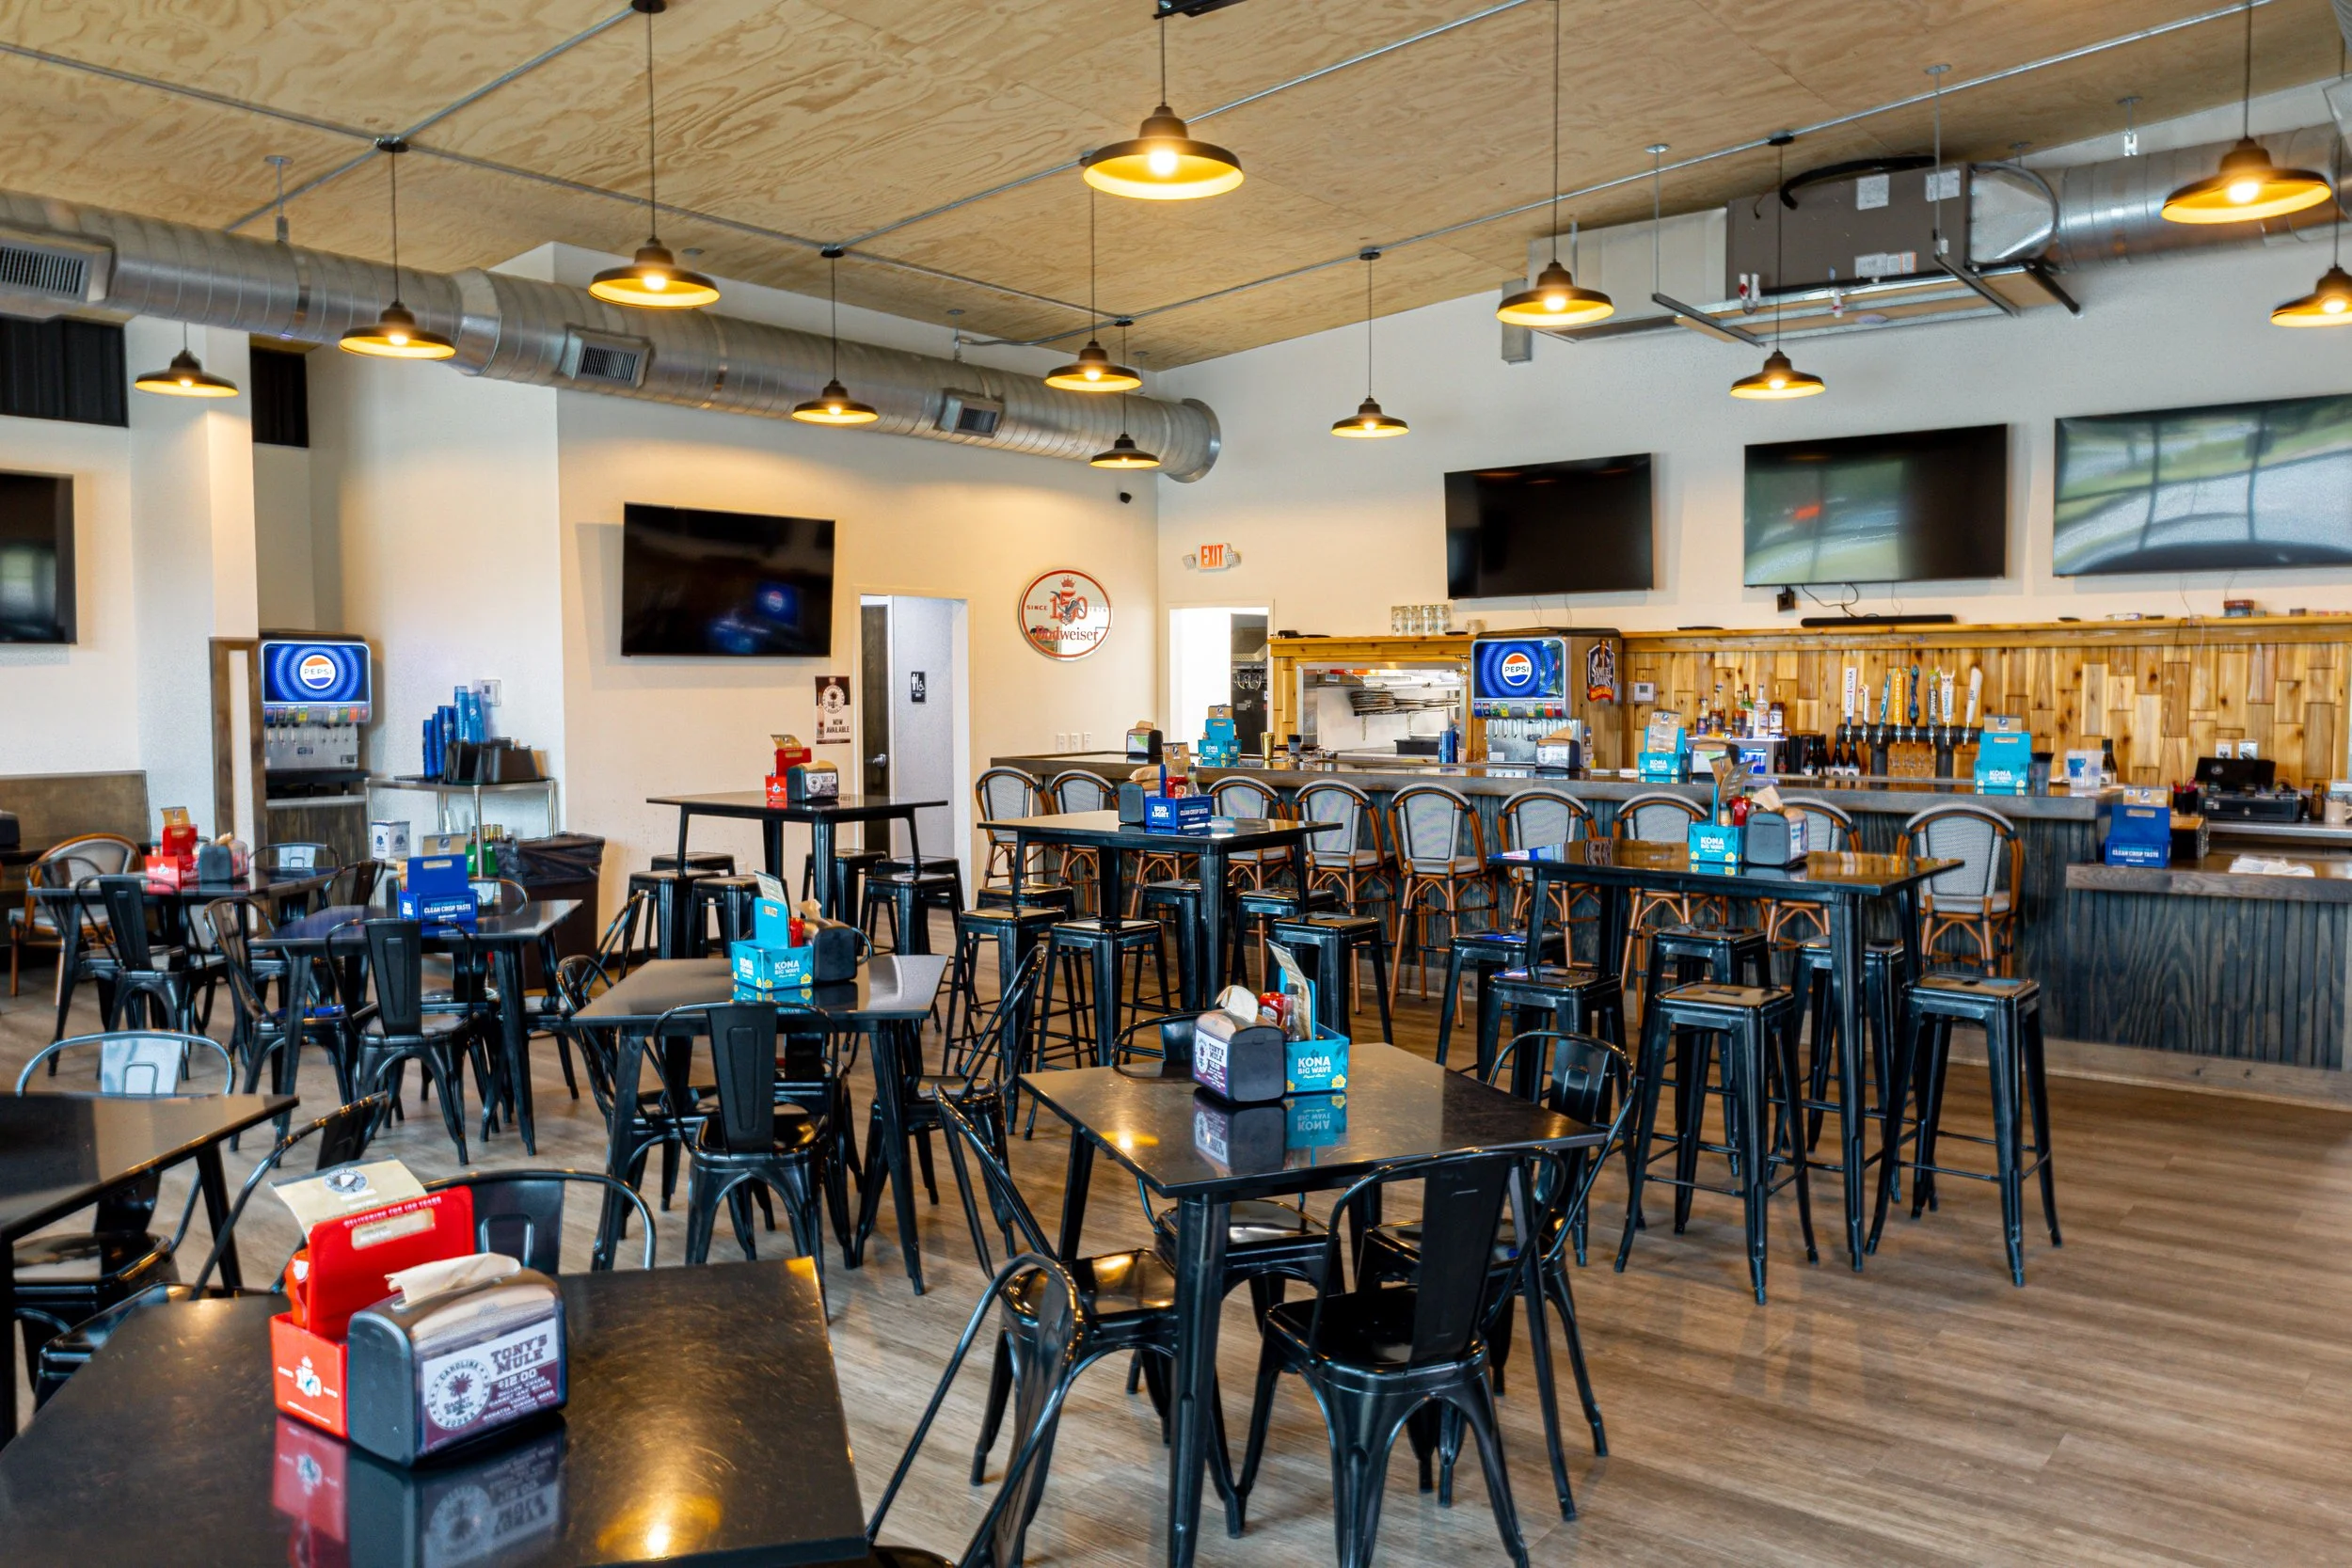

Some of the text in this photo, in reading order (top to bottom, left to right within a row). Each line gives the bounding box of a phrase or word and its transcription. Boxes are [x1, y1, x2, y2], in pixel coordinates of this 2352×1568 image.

[1201, 545, 1223, 568] EXIT
[1036, 625, 1099, 641] Budweiser
[1505, 665, 1530, 673] PEPSI
[1700, 836, 1724, 846] KONA
[441, 904, 455, 912] CRISP
[775, 959, 800, 969] KONA
[1297, 1055, 1331, 1069] KONA
[1297, 1067, 1311, 1075] BIG
[343, 1210, 388, 1228] DELIVERING
[389, 1206, 403, 1216] FOR
[419, 1196, 442, 1209] YEARS
[490, 1334, 548, 1363] TONY'S
[496, 1348, 544, 1375] MULE
[498, 1368, 538, 1388] $12.00
